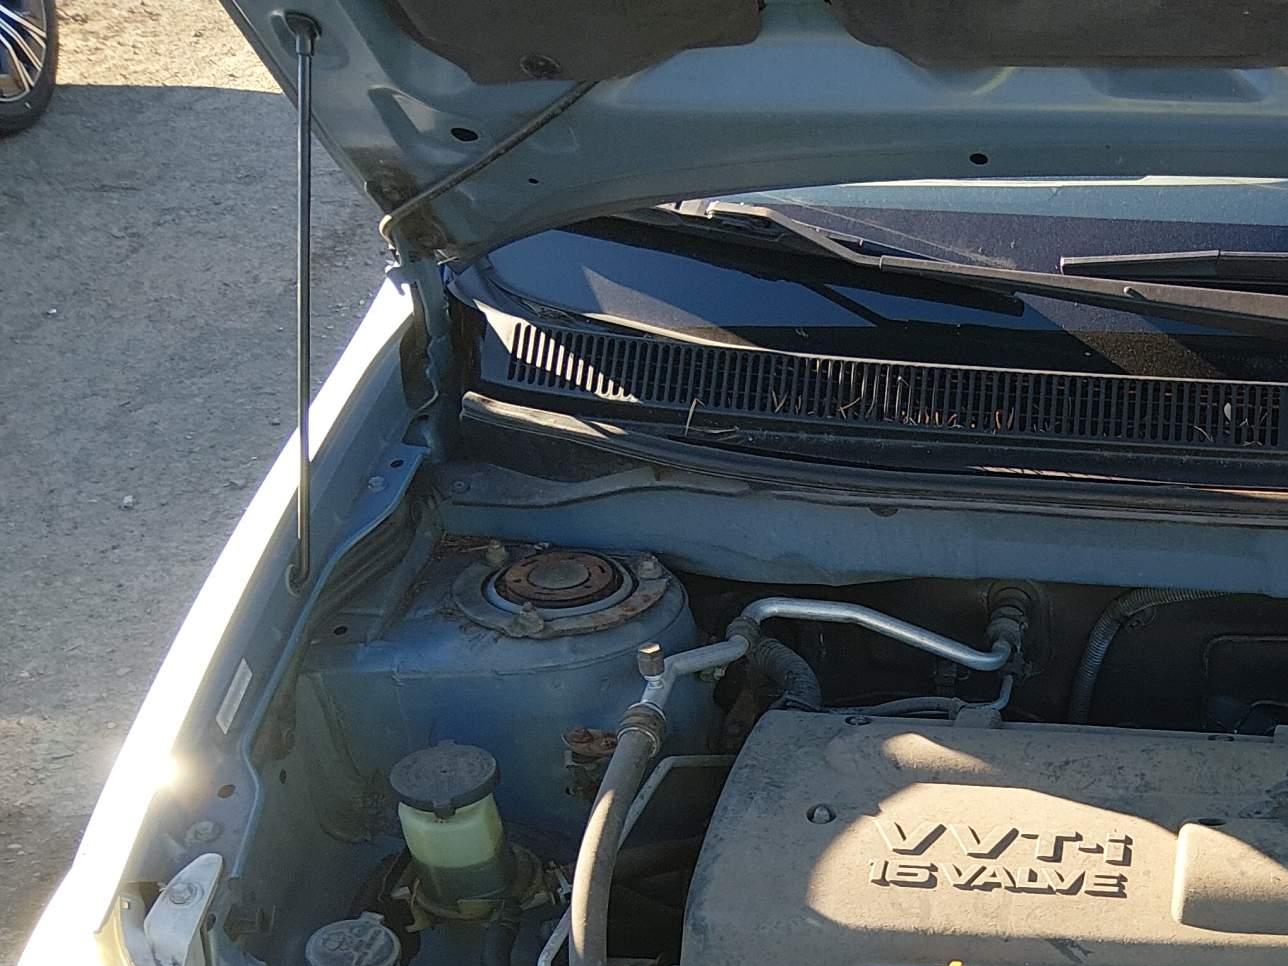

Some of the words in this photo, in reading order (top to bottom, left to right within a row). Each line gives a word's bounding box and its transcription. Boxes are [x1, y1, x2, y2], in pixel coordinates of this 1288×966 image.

[873, 820, 1134, 866] VVT-i
[869, 859, 938, 889] 16
[941, 863, 1128, 898] VALVE
